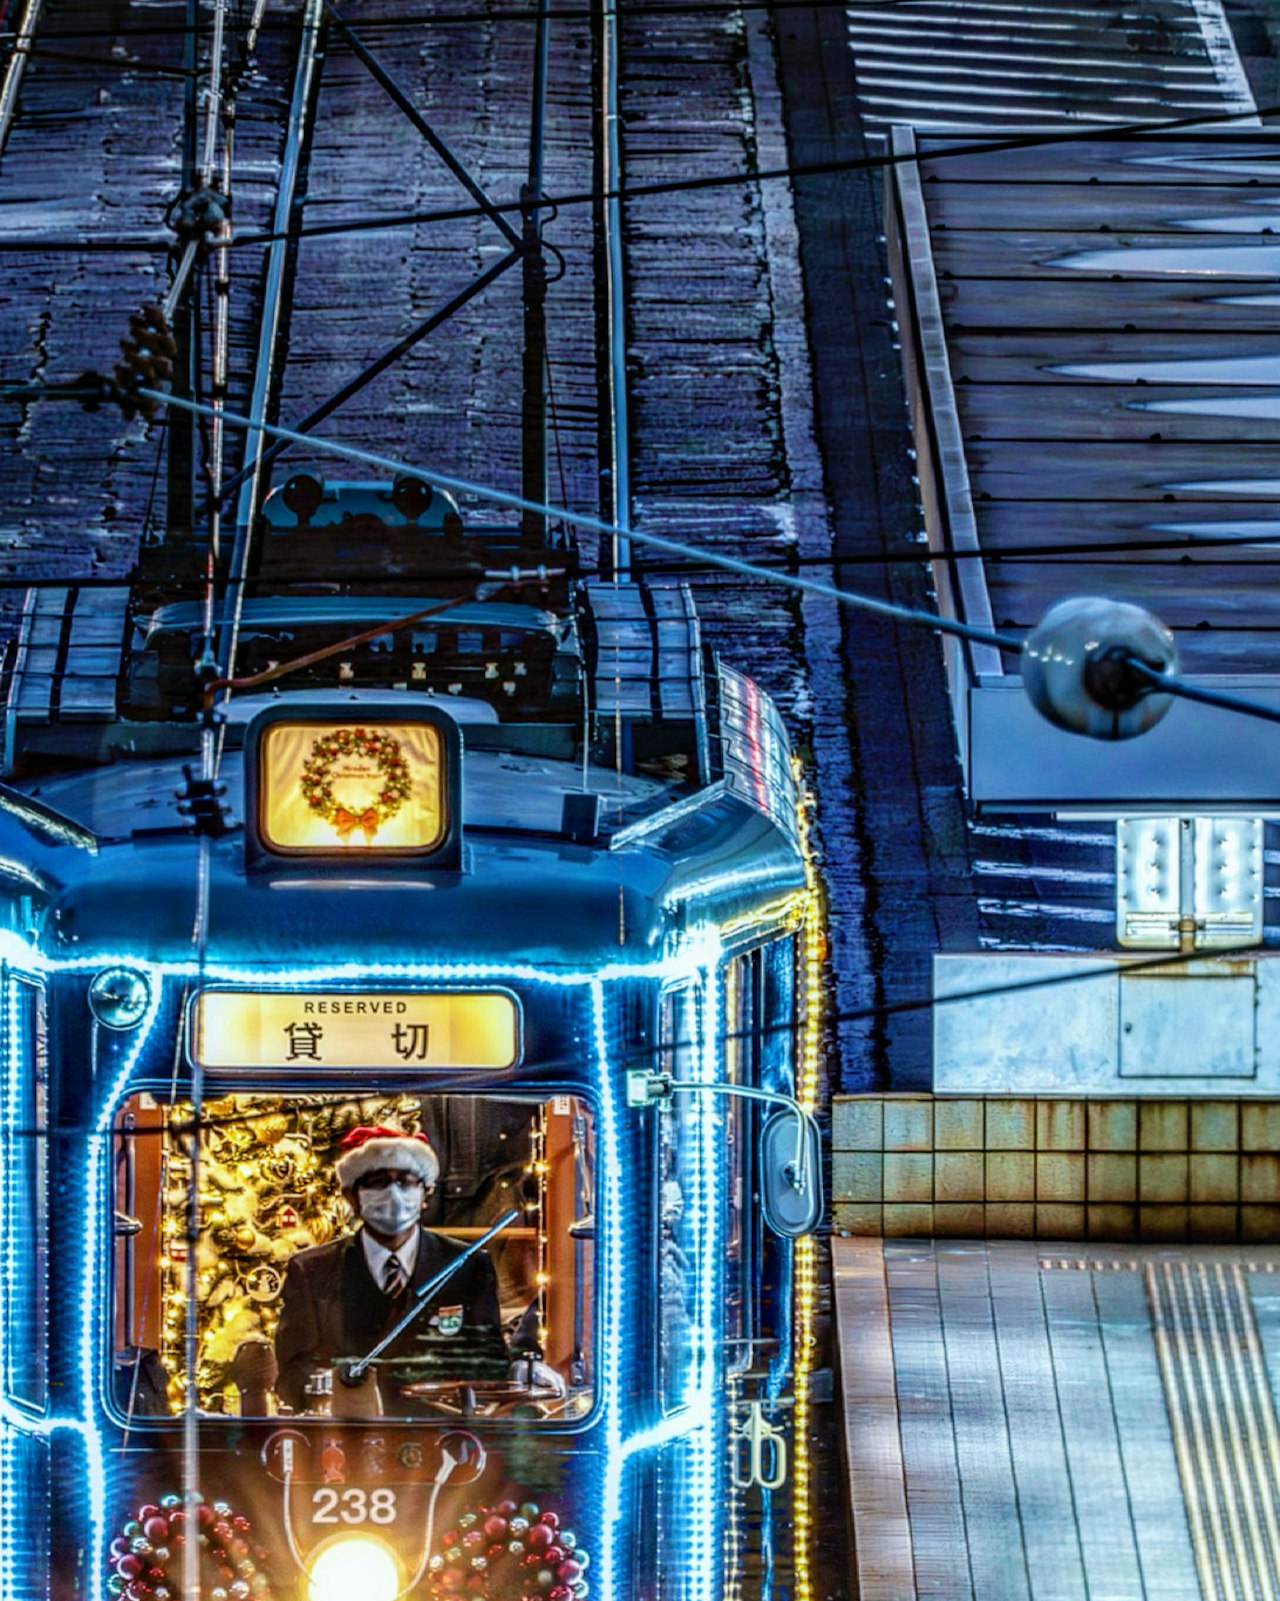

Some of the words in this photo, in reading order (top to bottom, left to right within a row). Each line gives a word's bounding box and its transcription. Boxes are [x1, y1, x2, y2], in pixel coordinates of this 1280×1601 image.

[303, 1001, 408, 1014] RESERVED
[283, 1021, 430, 1061] 貸切
[311, 1487, 398, 1525] 238
